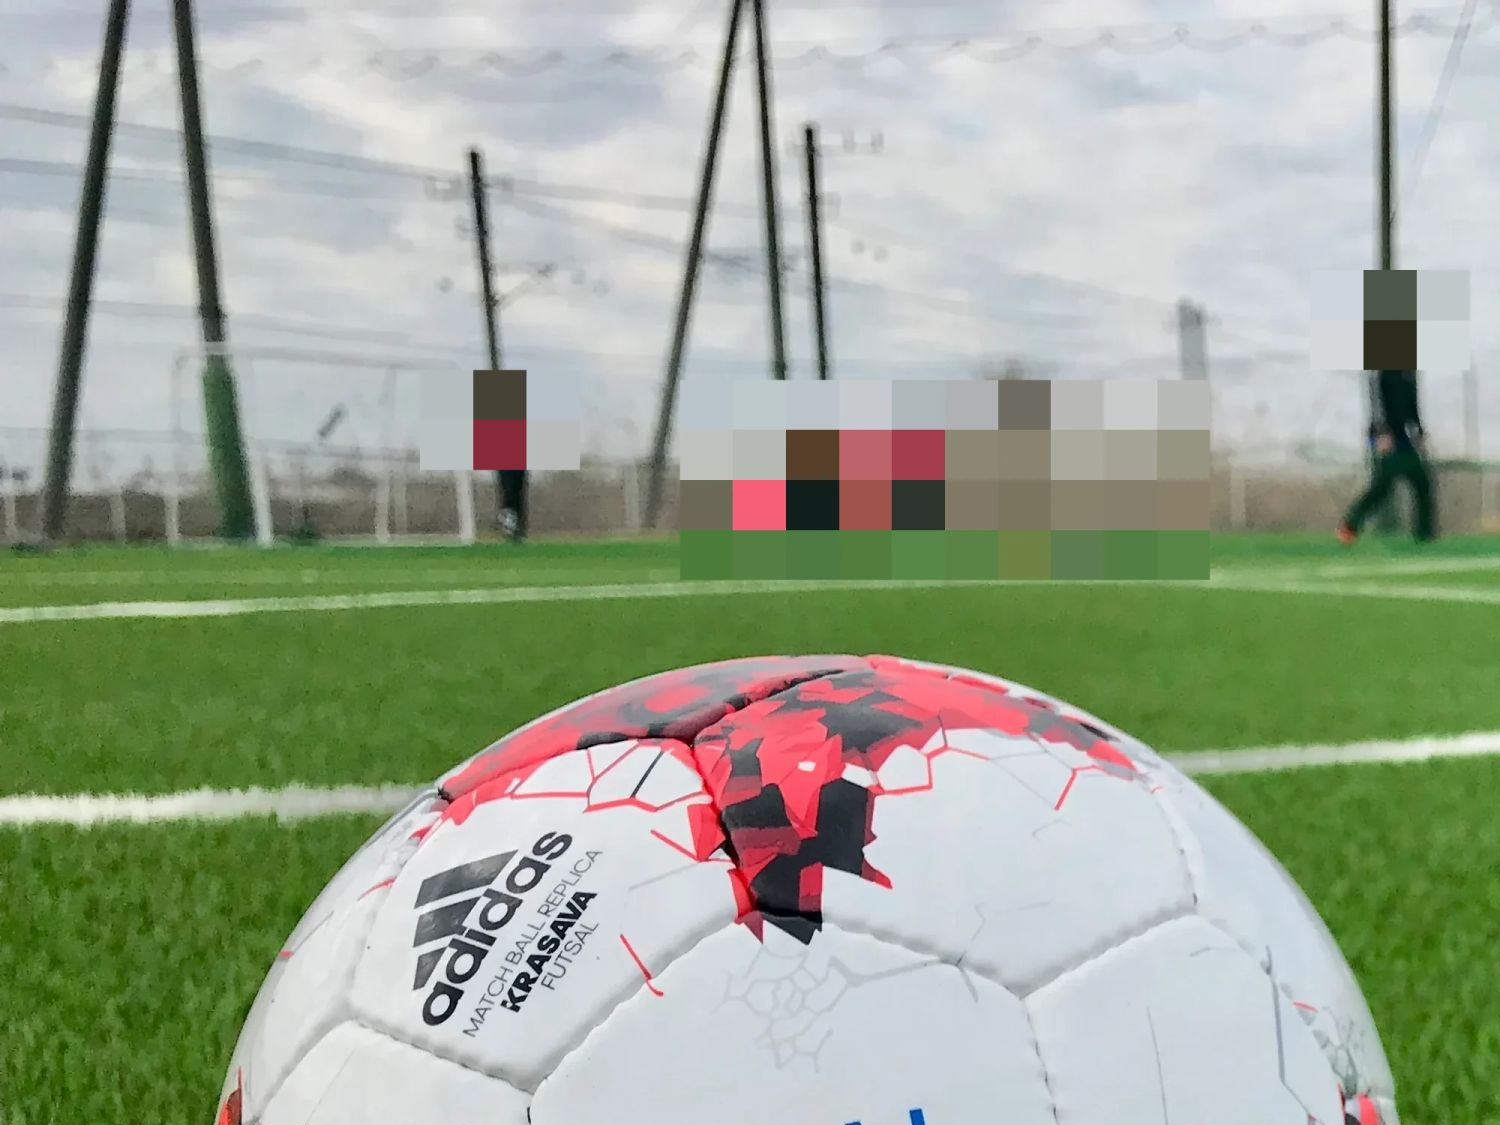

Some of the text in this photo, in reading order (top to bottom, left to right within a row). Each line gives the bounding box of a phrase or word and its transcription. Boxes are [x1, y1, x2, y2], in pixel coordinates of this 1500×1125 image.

[422, 831, 573, 1026] adidas
[462, 850, 603, 1038] MATCH BALL REPLICA
[500, 891, 598, 1013] KRASAVA
[541, 922, 599, 991] FUTSAL
